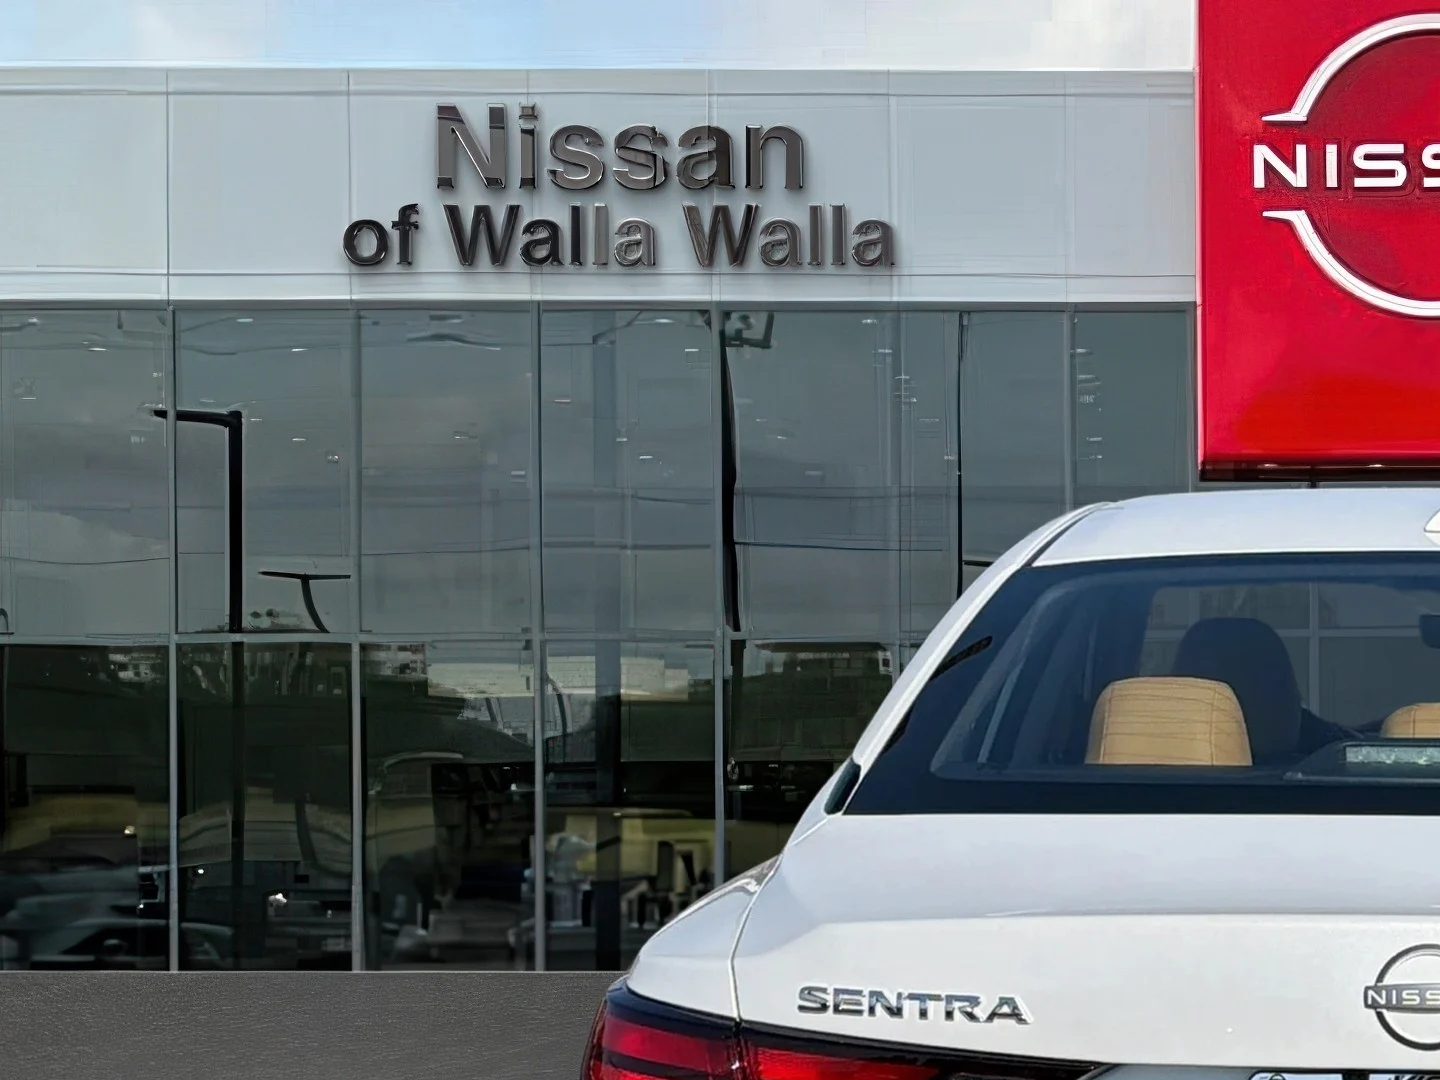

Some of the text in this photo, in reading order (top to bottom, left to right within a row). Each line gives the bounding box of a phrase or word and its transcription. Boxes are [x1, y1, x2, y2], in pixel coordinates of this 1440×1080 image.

[436, 101, 804, 190] Nissan
[342, 202, 898, 267] of Walla Walla
[797, 985, 1031, 1025] SENTRA
